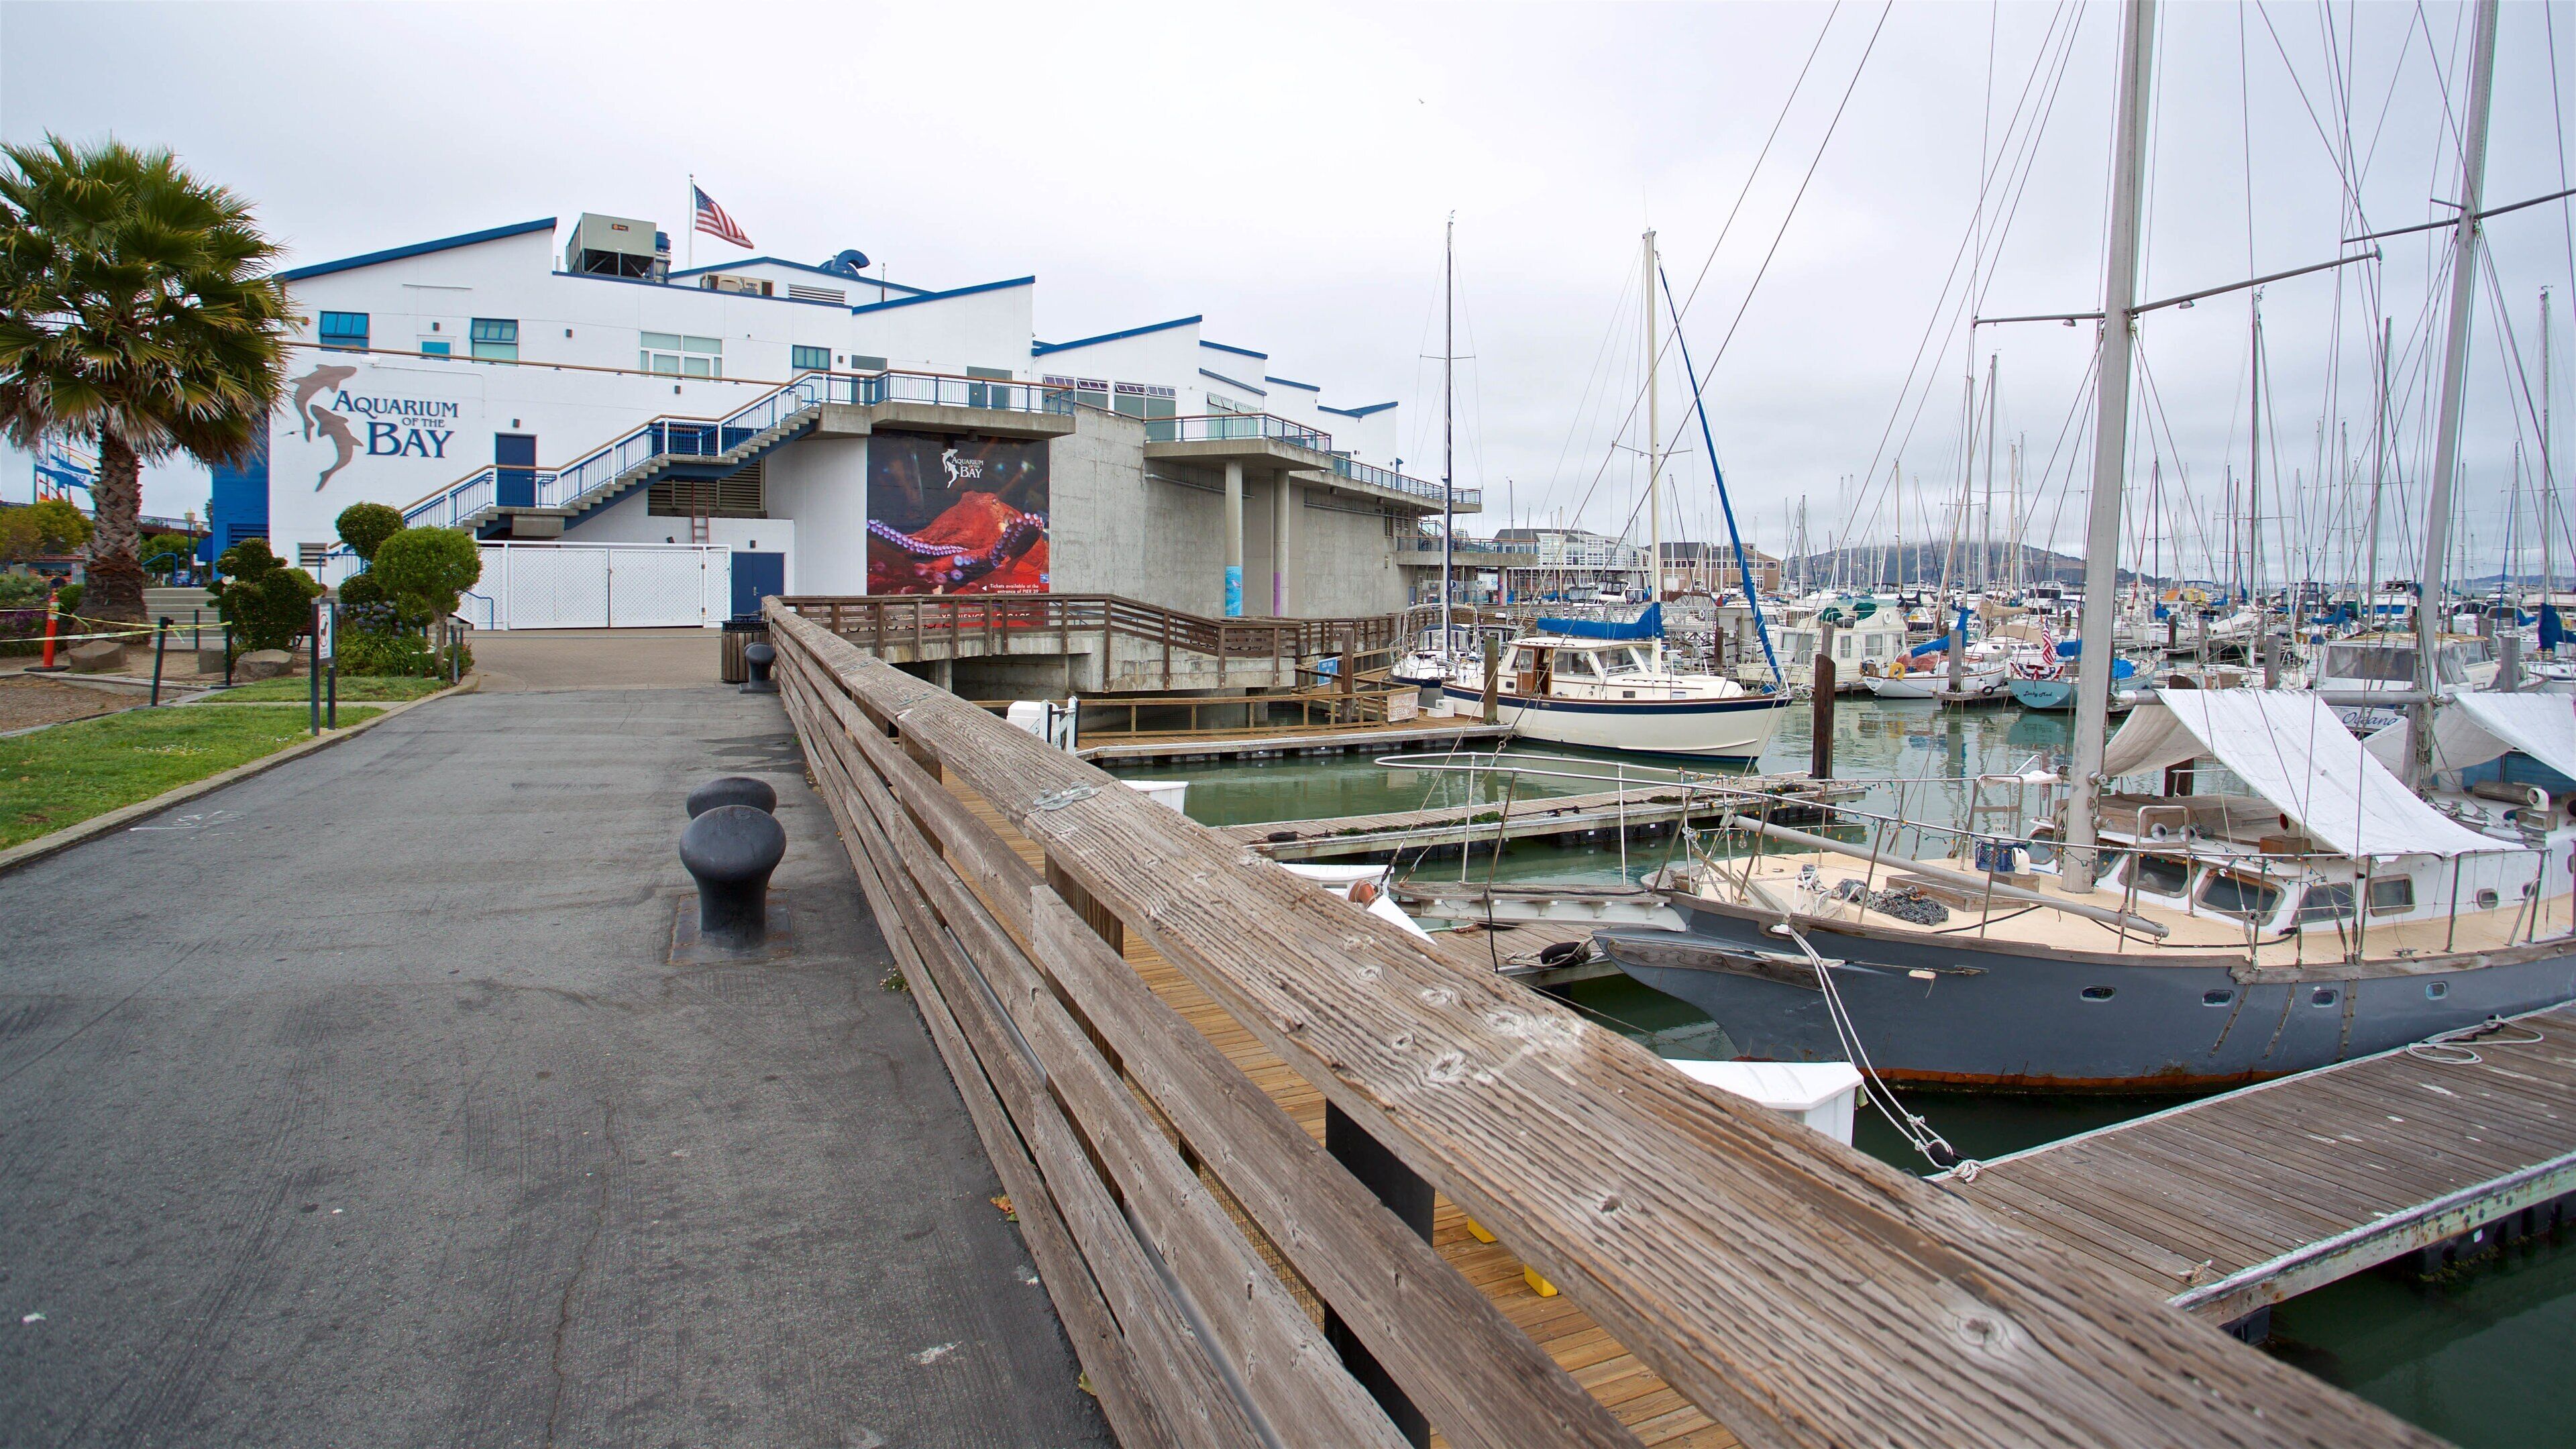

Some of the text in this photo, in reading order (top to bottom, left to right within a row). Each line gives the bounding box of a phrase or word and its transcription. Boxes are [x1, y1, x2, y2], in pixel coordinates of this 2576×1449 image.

[331, 390, 459, 419] AQUARIUM
[402, 417, 445, 427] OF THE
[366, 421, 455, 458] BAY
[952, 456, 983, 466] AQUARIUM
[960, 466, 982, 478] BAY
